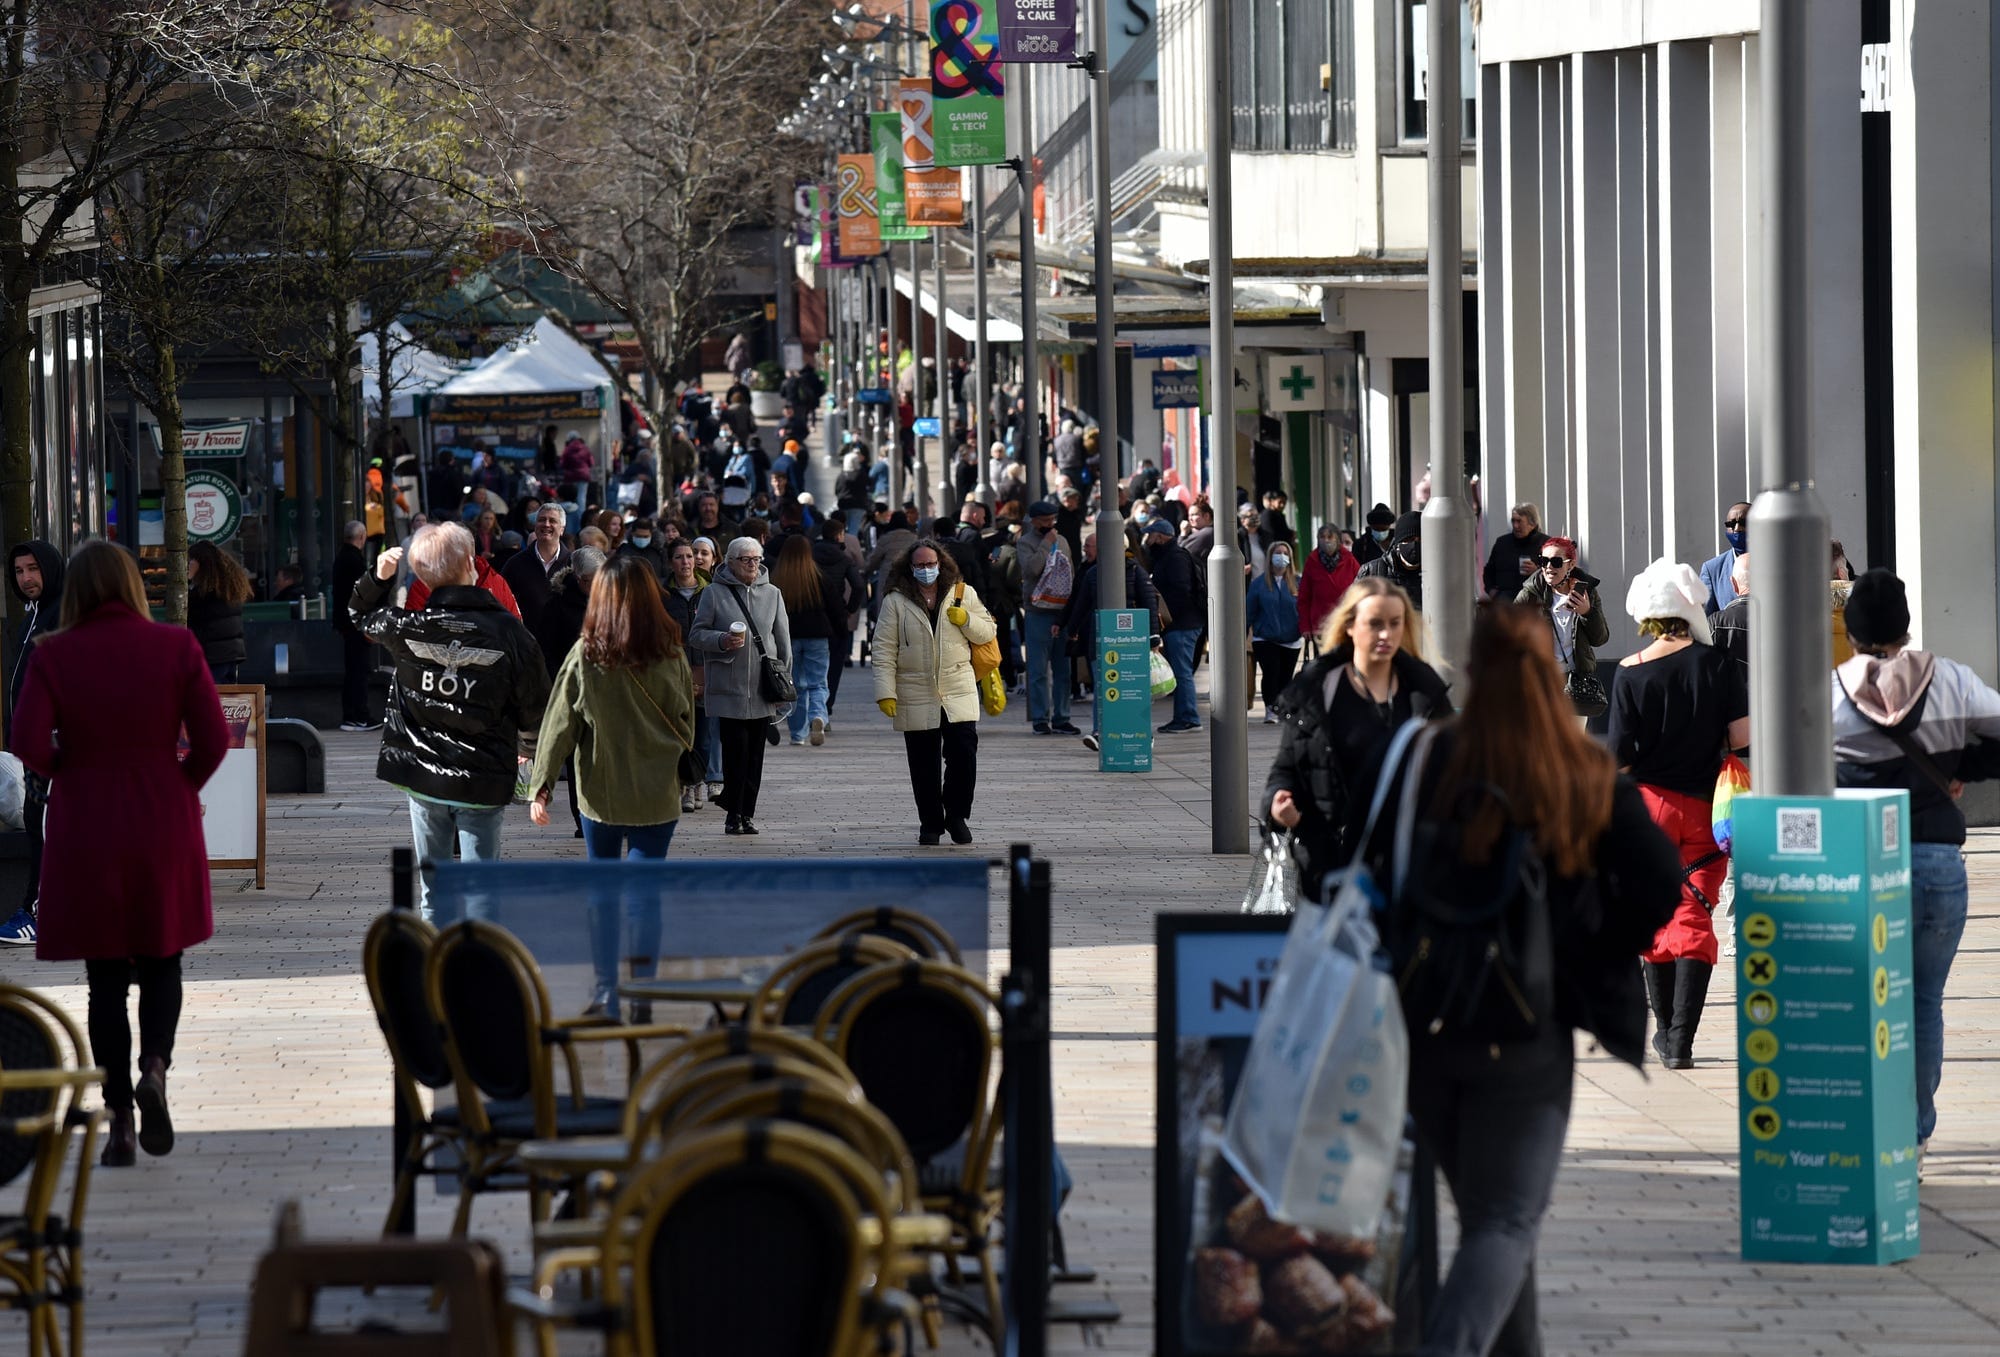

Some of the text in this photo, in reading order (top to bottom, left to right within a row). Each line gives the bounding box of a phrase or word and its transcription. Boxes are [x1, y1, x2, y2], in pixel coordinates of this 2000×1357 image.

[1015, 0, 1056, 9] COFFEE
[1017, 11, 1056, 20] & CAKE
[949, 112, 988, 121] GAMING
[951, 121, 986, 131] & TECH
[1154, 385, 1199, 395] HALIFA
[422, 671, 477, 699] BOY
[1741, 872, 1861, 894] Stay Safe Sheff
[1755, 1150, 1860, 1168] Play Your Part
